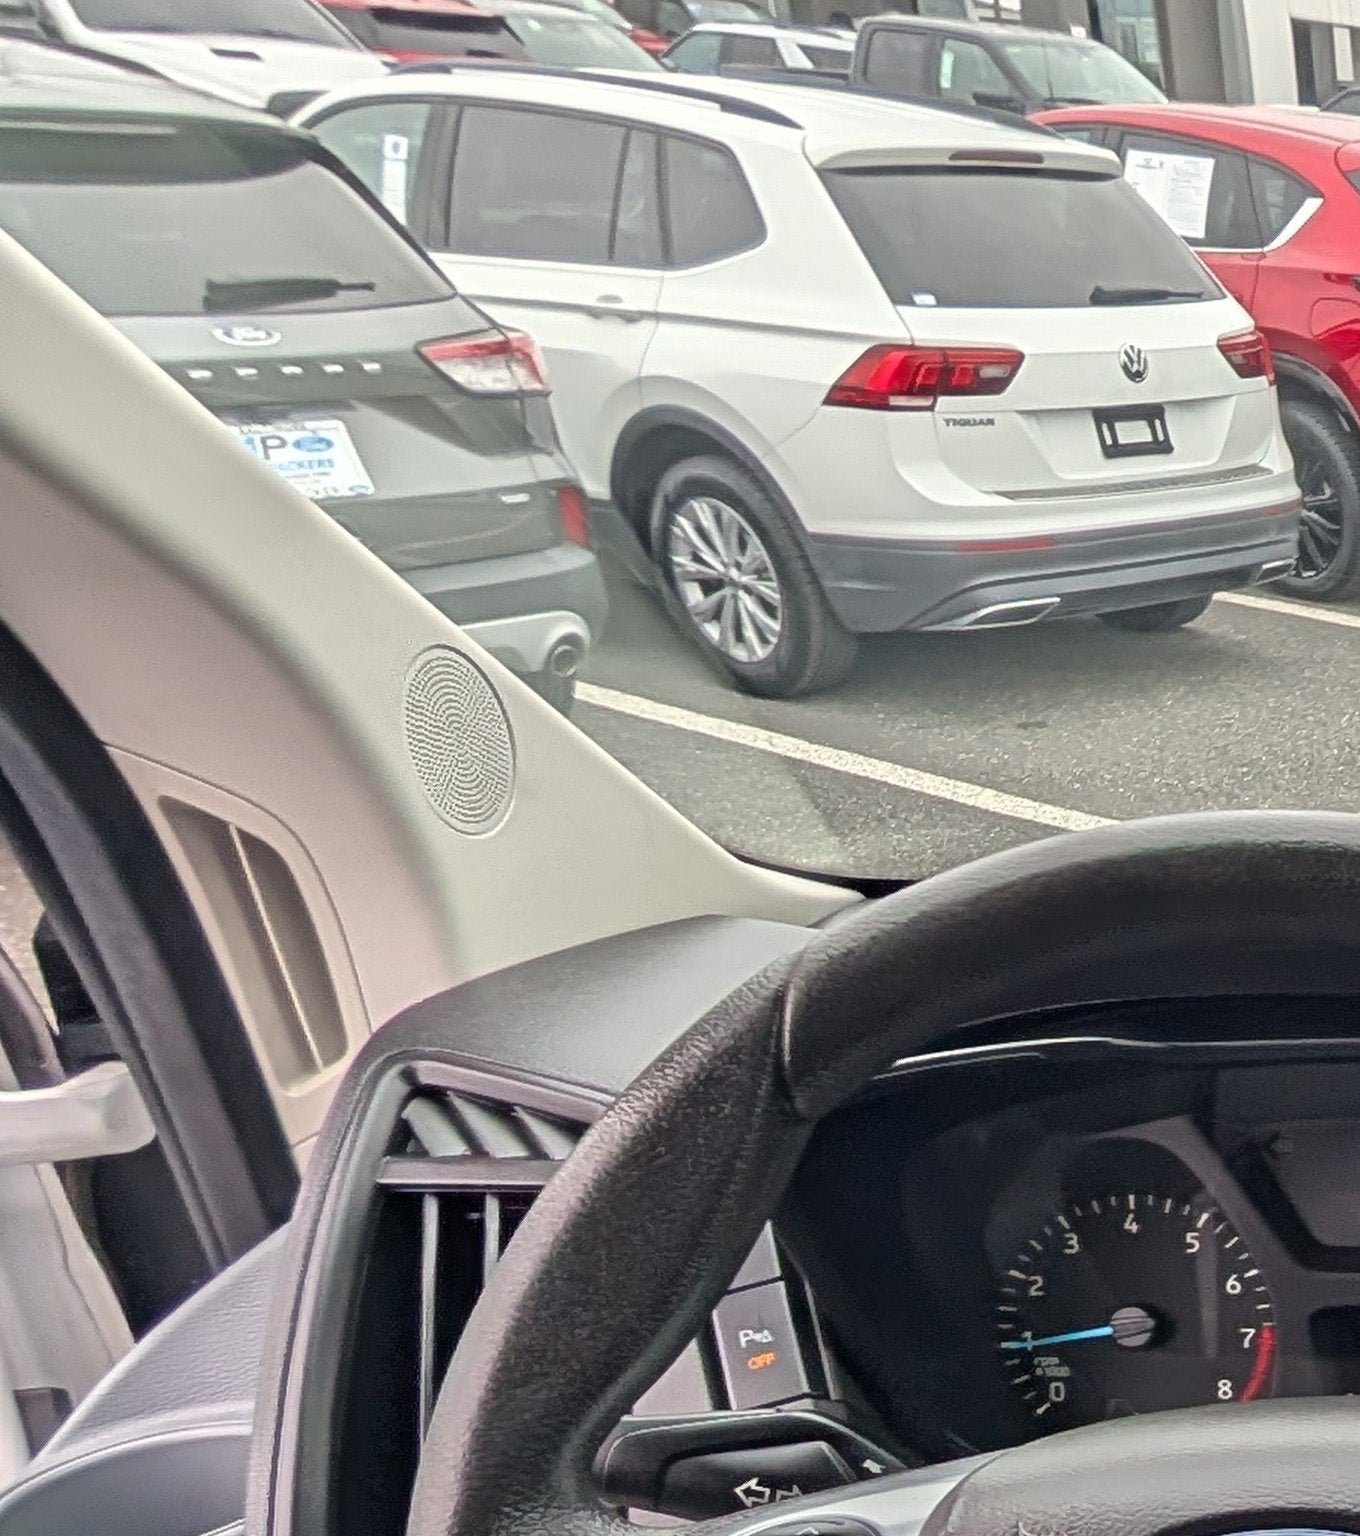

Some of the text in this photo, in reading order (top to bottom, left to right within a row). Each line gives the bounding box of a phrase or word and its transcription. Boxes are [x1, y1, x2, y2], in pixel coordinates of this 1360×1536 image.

[1123, 1213, 1139, 1234] 4
[1063, 1232, 1080, 1254] 3
[1185, 1232, 1200, 1254] 5
[1028, 1275, 1044, 1297] 2
[1225, 1274, 1242, 1295] 6
[1240, 1328, 1256, 1349] 7
[747, 1352, 776, 1370] OFF
[1049, 1381, 1066, 1402] 0
[1217, 1379, 1233, 1400] 8
